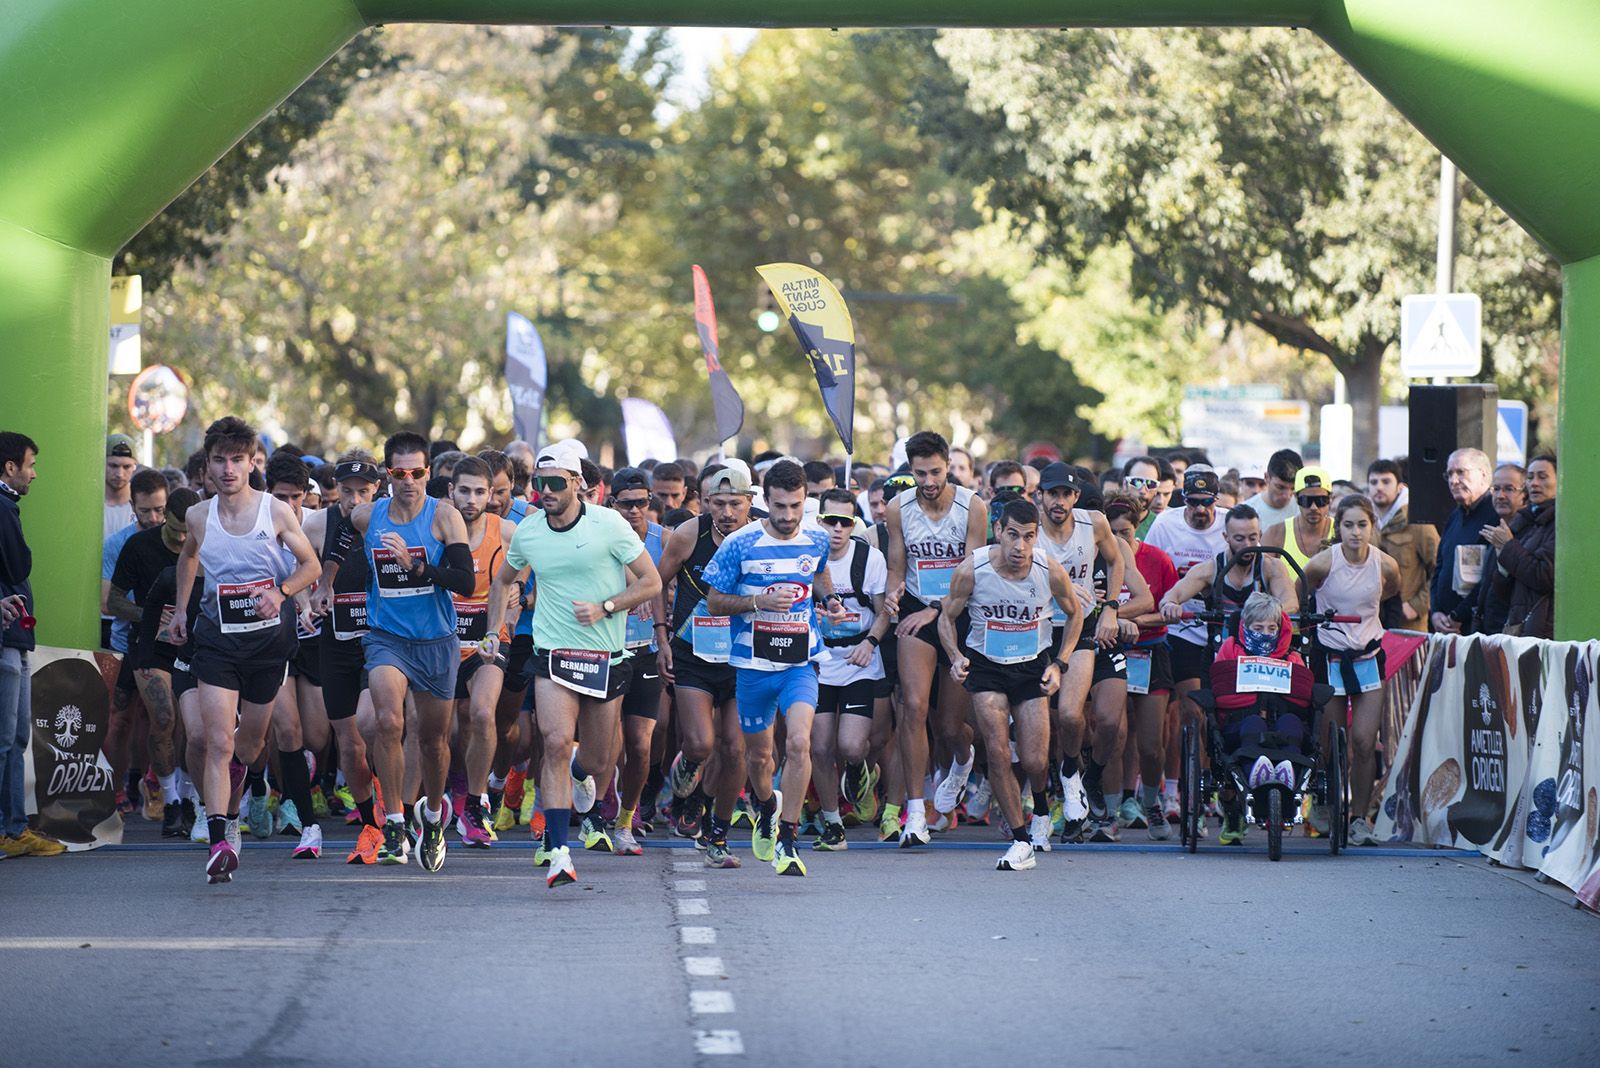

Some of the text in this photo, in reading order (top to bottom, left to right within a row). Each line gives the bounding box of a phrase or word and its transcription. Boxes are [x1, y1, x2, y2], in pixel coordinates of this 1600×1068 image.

[381, 563, 403, 574] JORGE
[769, 637, 793, 648] JOSEP
[778, 648, 782, 656] 1
[560, 659, 599, 674] BERNARDO
[36, 718, 49, 728] EST.
[1472, 756, 1505, 792] ORIGEN
